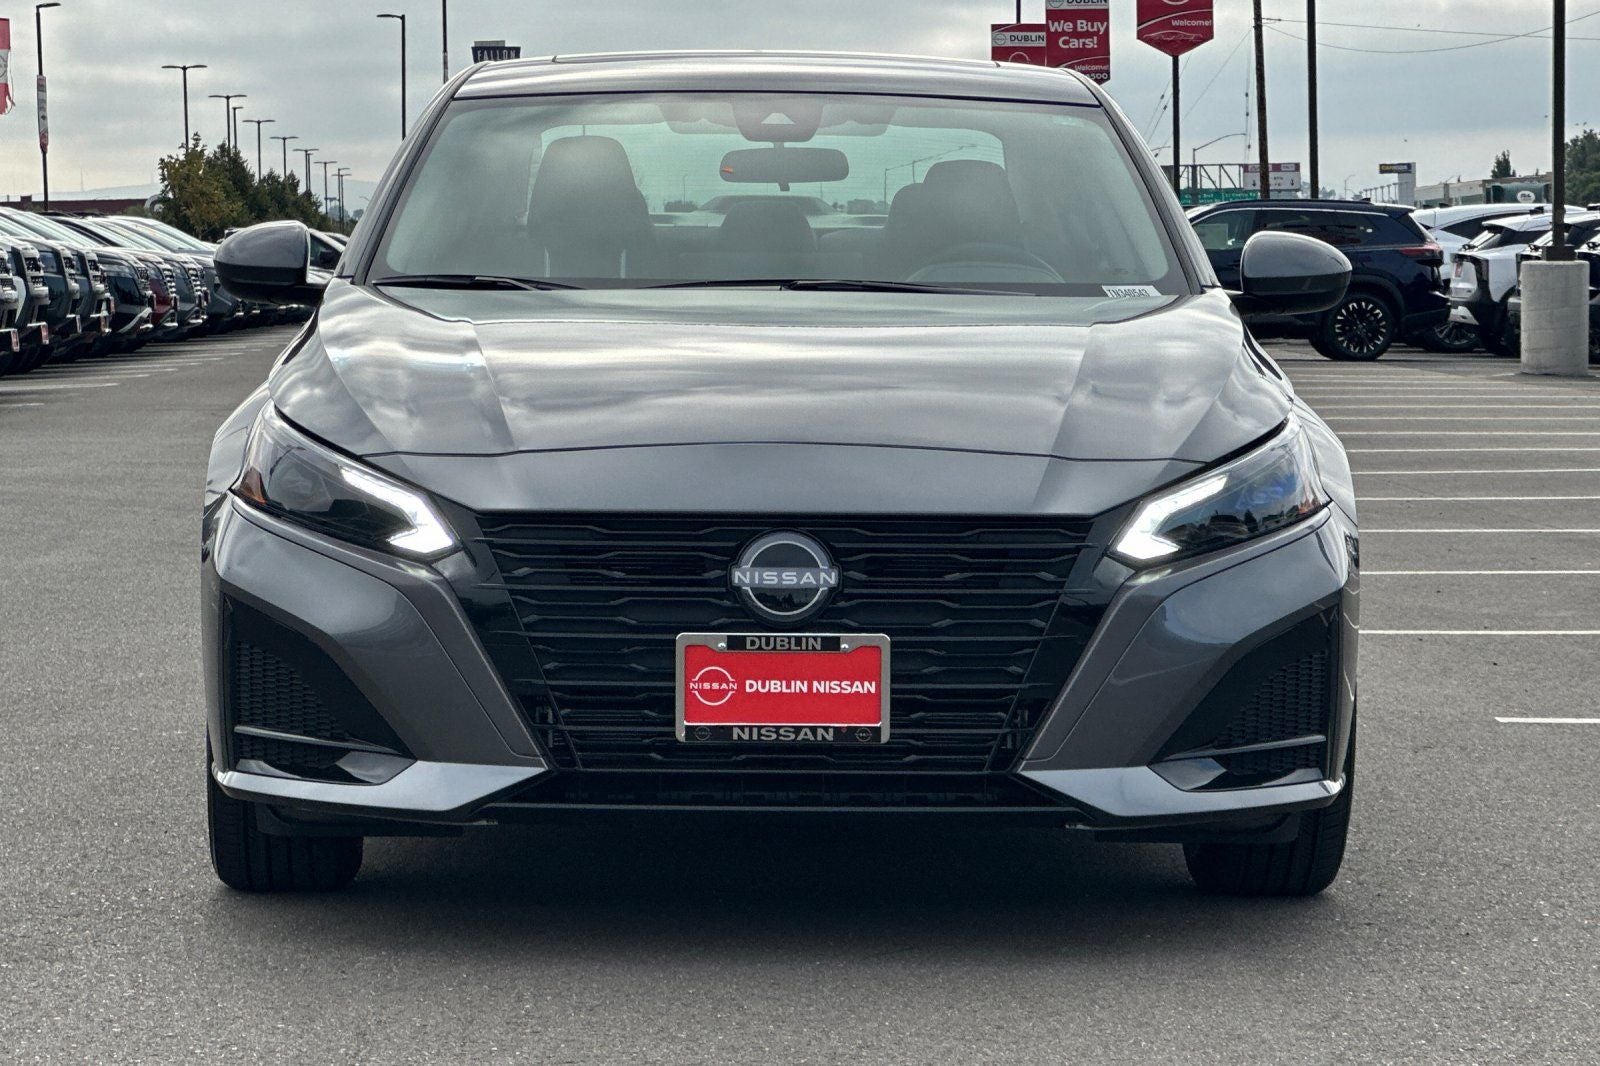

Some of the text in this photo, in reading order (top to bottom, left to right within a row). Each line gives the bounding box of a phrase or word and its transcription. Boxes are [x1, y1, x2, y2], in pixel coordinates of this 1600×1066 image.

[1048, 20, 1107, 34] We Buy
[1058, 36, 1098, 48] Cars!
[477, 50, 516, 61] FALLON
[734, 571, 836, 585] NISSAN
[746, 636, 822, 651] DUBLIN
[690, 682, 737, 690] NISSAN
[745, 680, 876, 693] DUBLIN NISSAN
[733, 727, 834, 741] NISSAN
